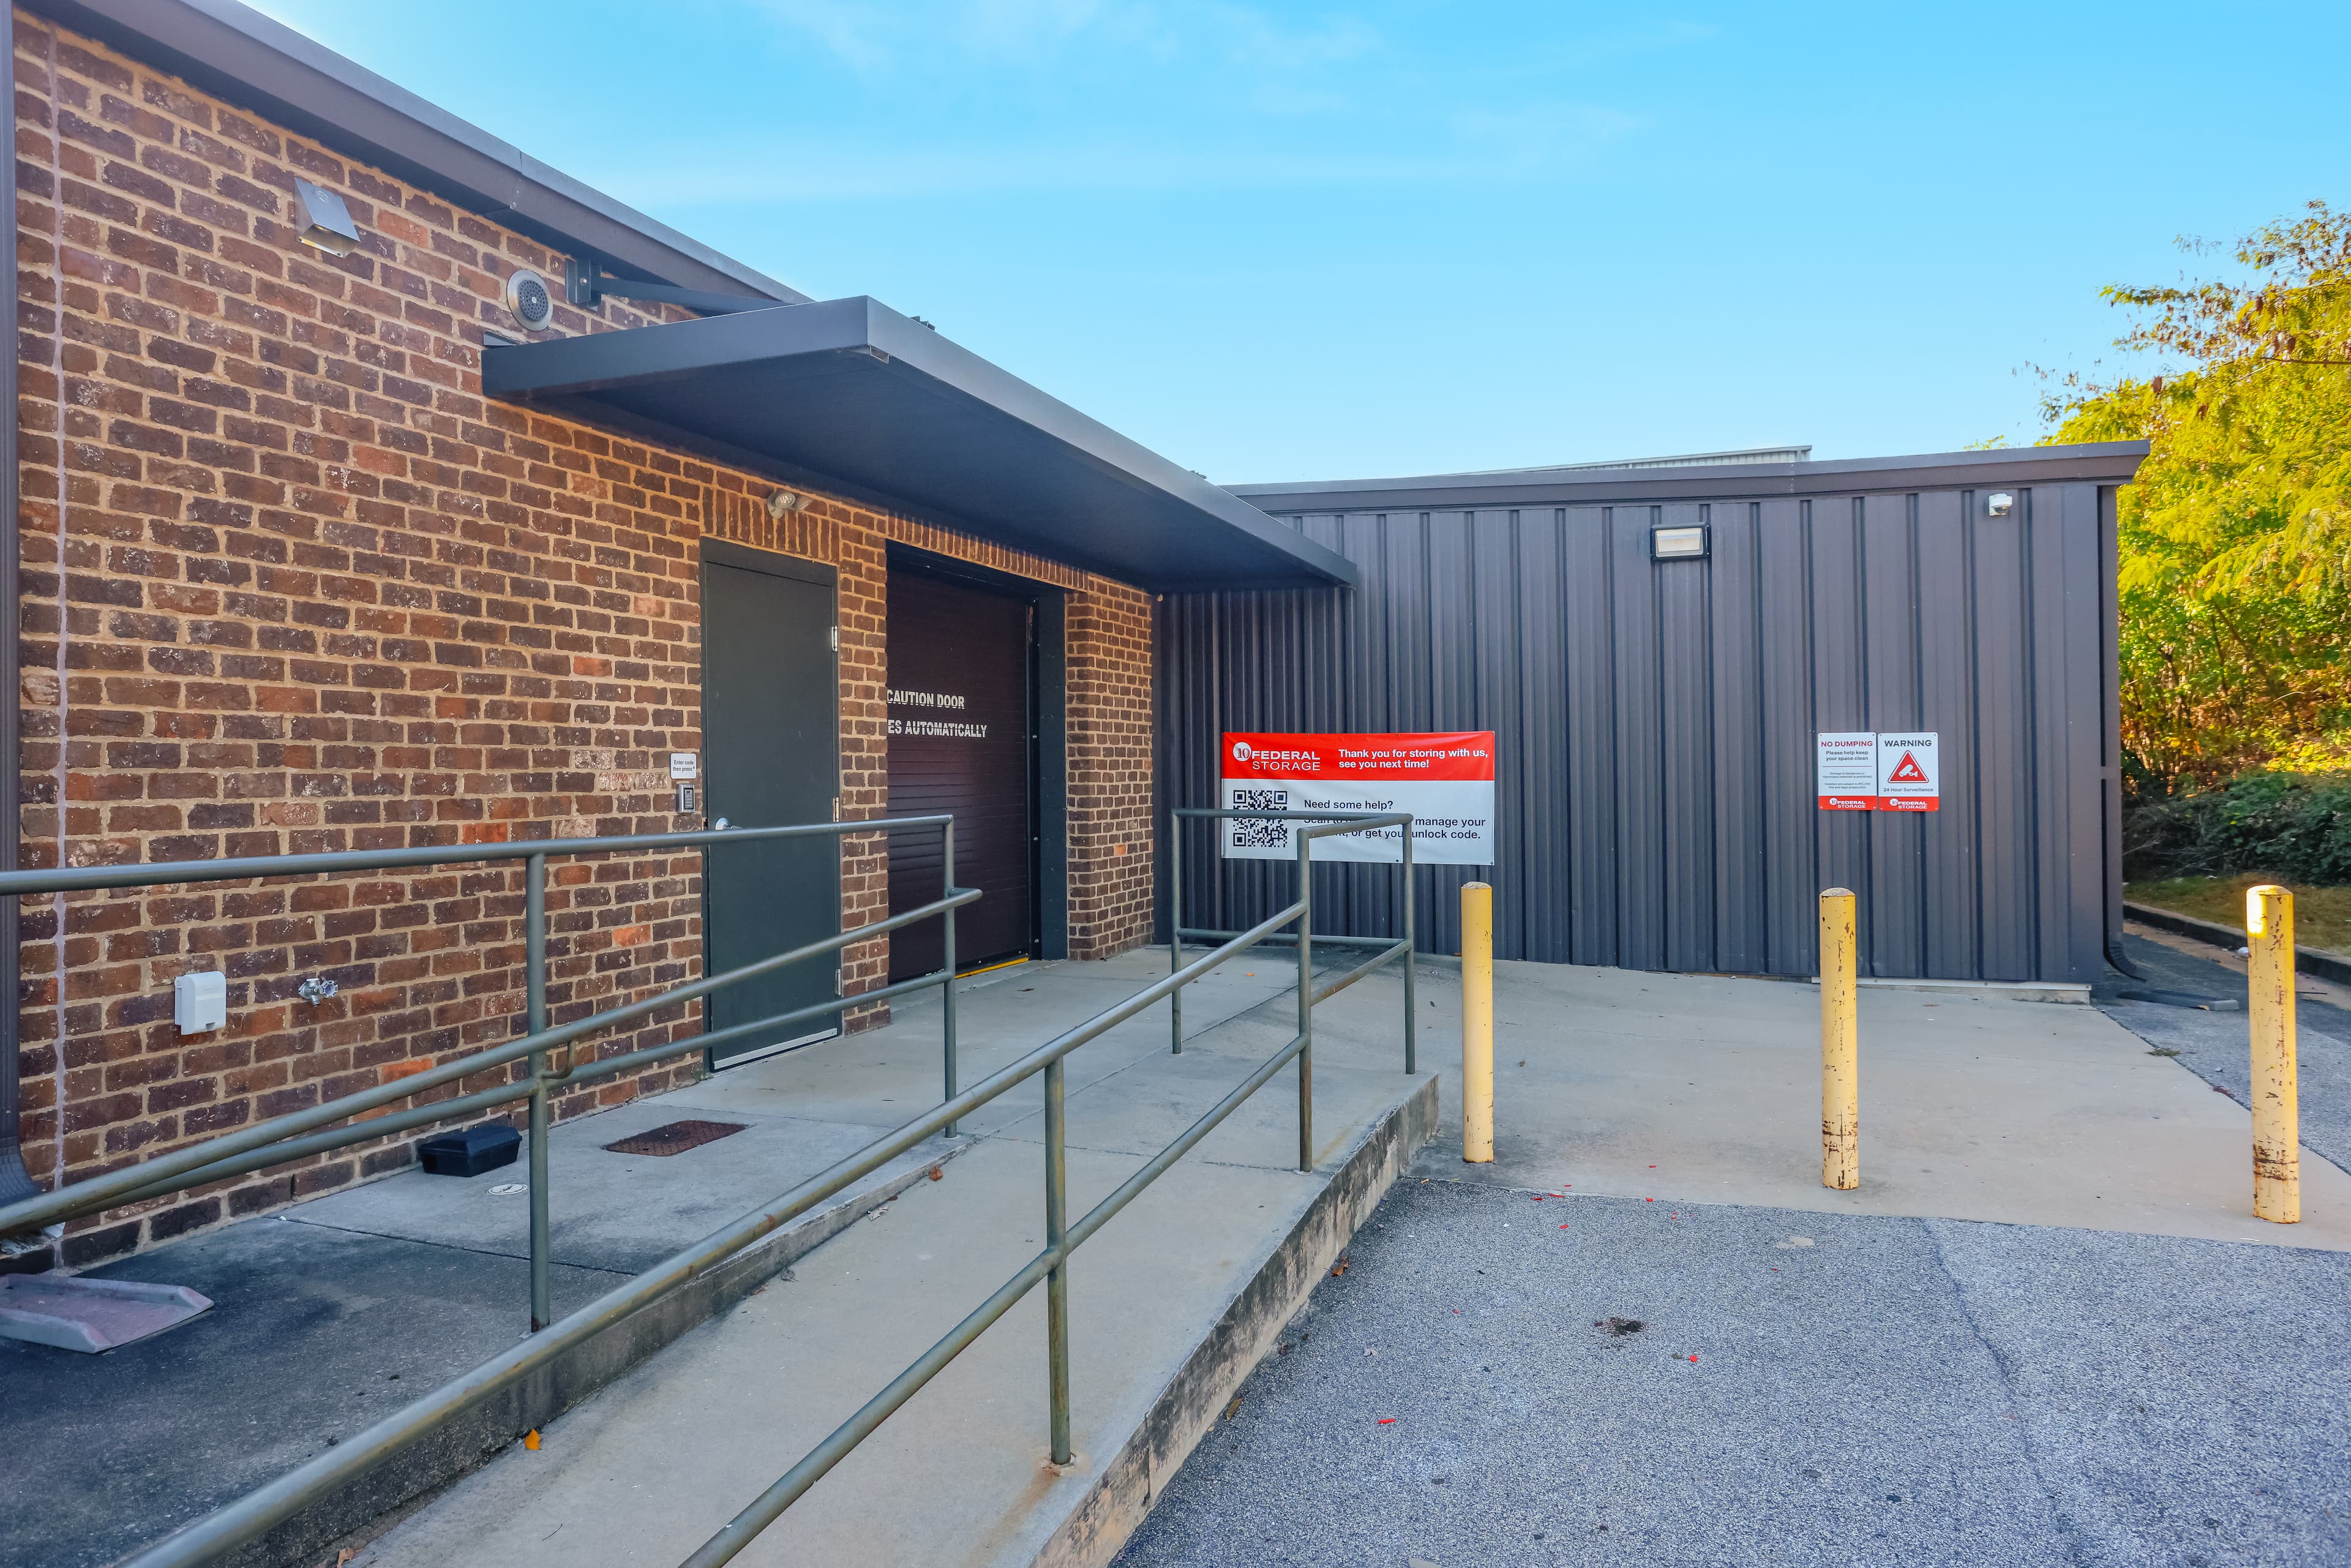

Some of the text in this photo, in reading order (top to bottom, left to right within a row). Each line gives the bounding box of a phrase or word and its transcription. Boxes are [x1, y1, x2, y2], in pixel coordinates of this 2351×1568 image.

[887, 689, 965, 709] CAUTION DOOR
[888, 719, 988, 738] ES AUTOMATICALLY
[1236, 748, 1321, 760] 10 FEDERAL
[1338, 748, 1488, 759] Thank you for storing with us,
[1252, 761, 1321, 771] STORAGE
[1359, 760, 1377, 769] you
[1379, 759, 1401, 768] next
[1404, 759, 1429, 768] time!
[1304, 799, 1330, 808] Need
[1365, 800, 1393, 811] help?
[1415, 819, 1458, 828] manage
[1461, 819, 1486, 828] your
[1365, 829, 1382, 838] get
[1385, 830, 1403, 839] you
[1412, 830, 1447, 838] unlock
[1450, 830, 1481, 839] code.
